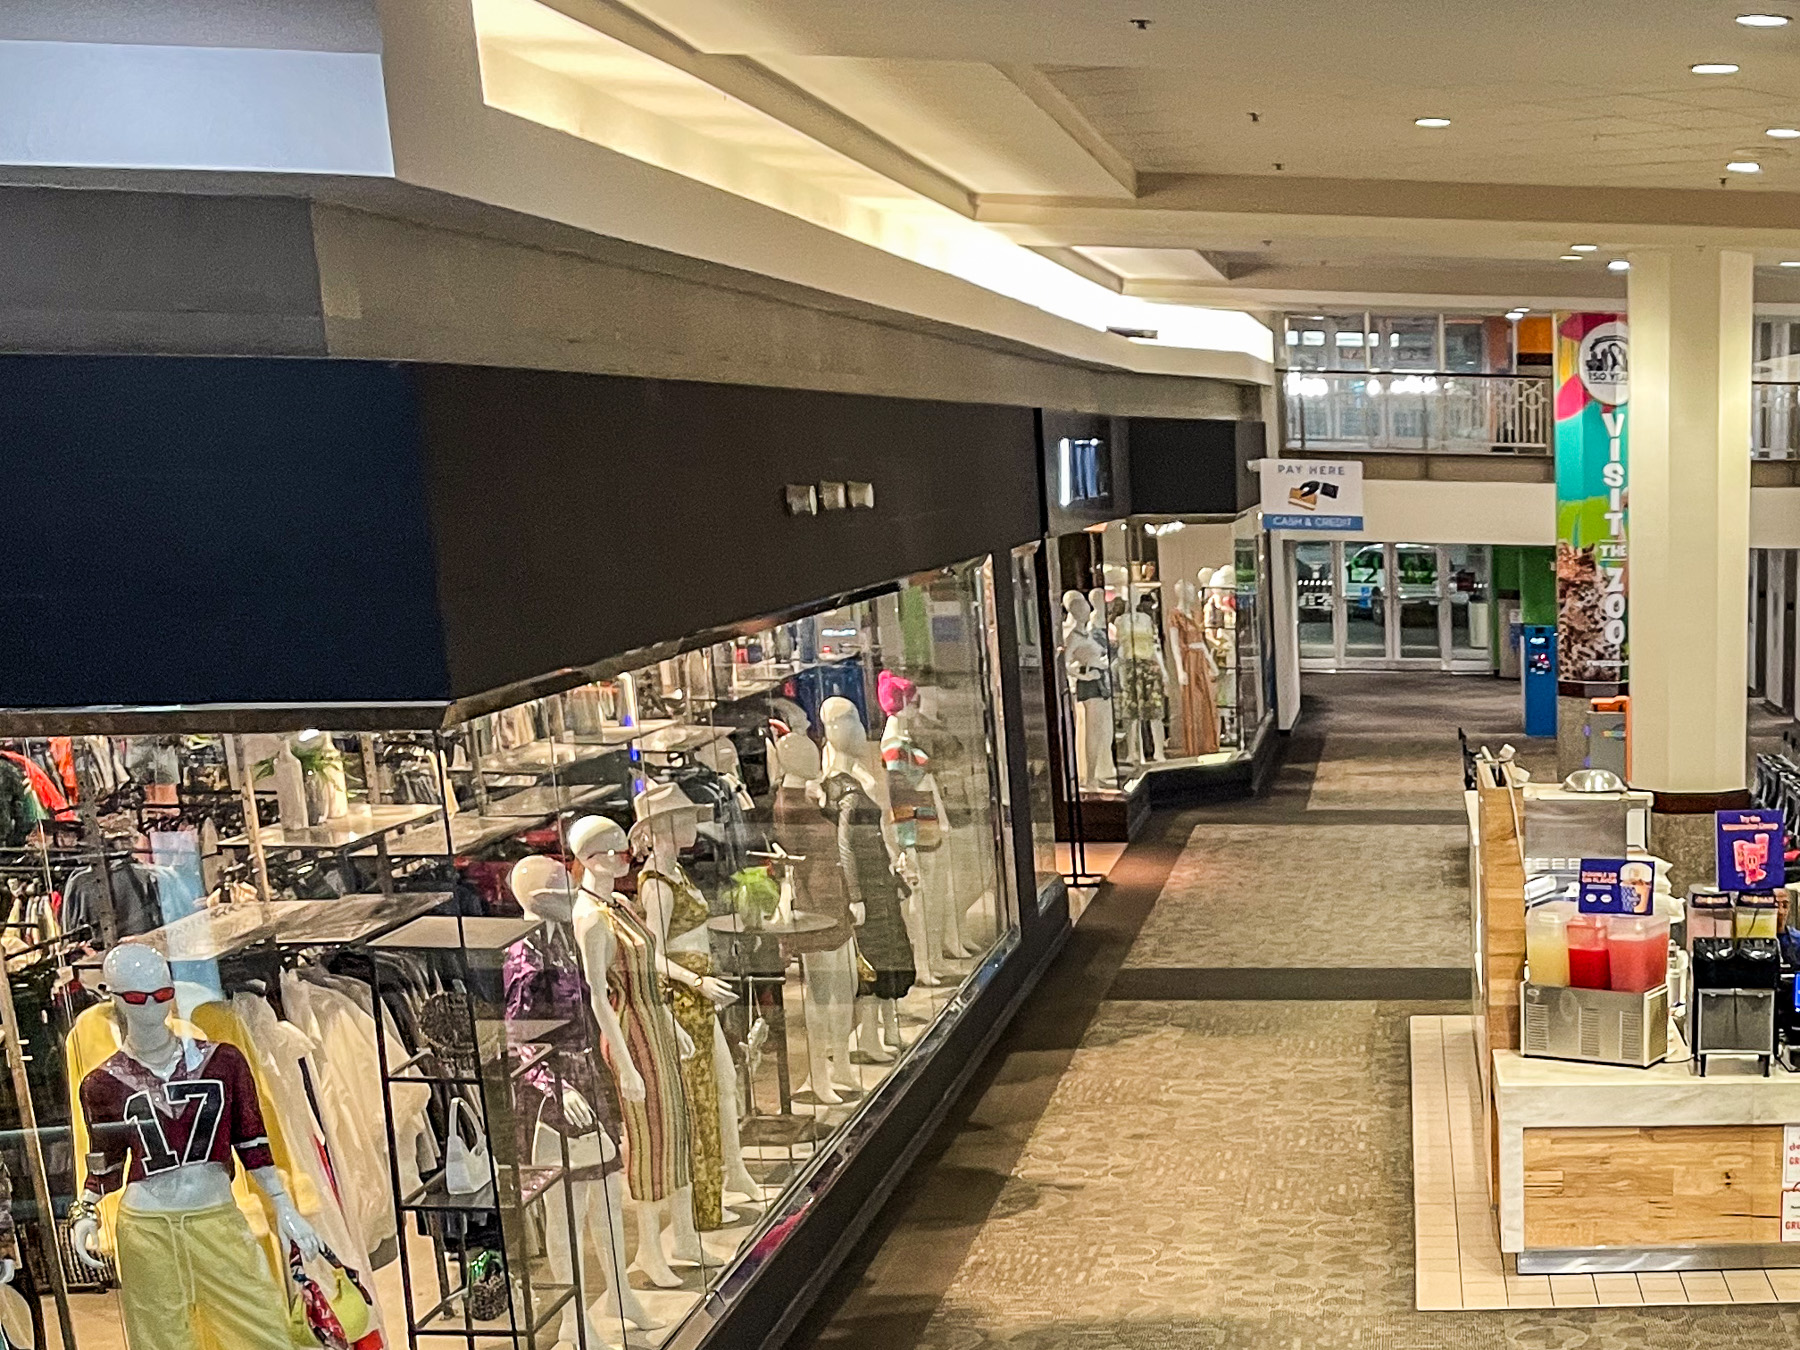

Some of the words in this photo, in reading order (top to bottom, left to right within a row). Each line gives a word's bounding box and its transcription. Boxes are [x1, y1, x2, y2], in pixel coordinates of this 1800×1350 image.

[1277, 464, 1303, 474] PAY
[1308, 466, 1345, 476] HERE
[1603, 412, 1625, 536] VISIT
[1600, 545, 1627, 558] THE
[1604, 567, 1626, 645] ZOO
[123, 1079, 225, 1176] 17
